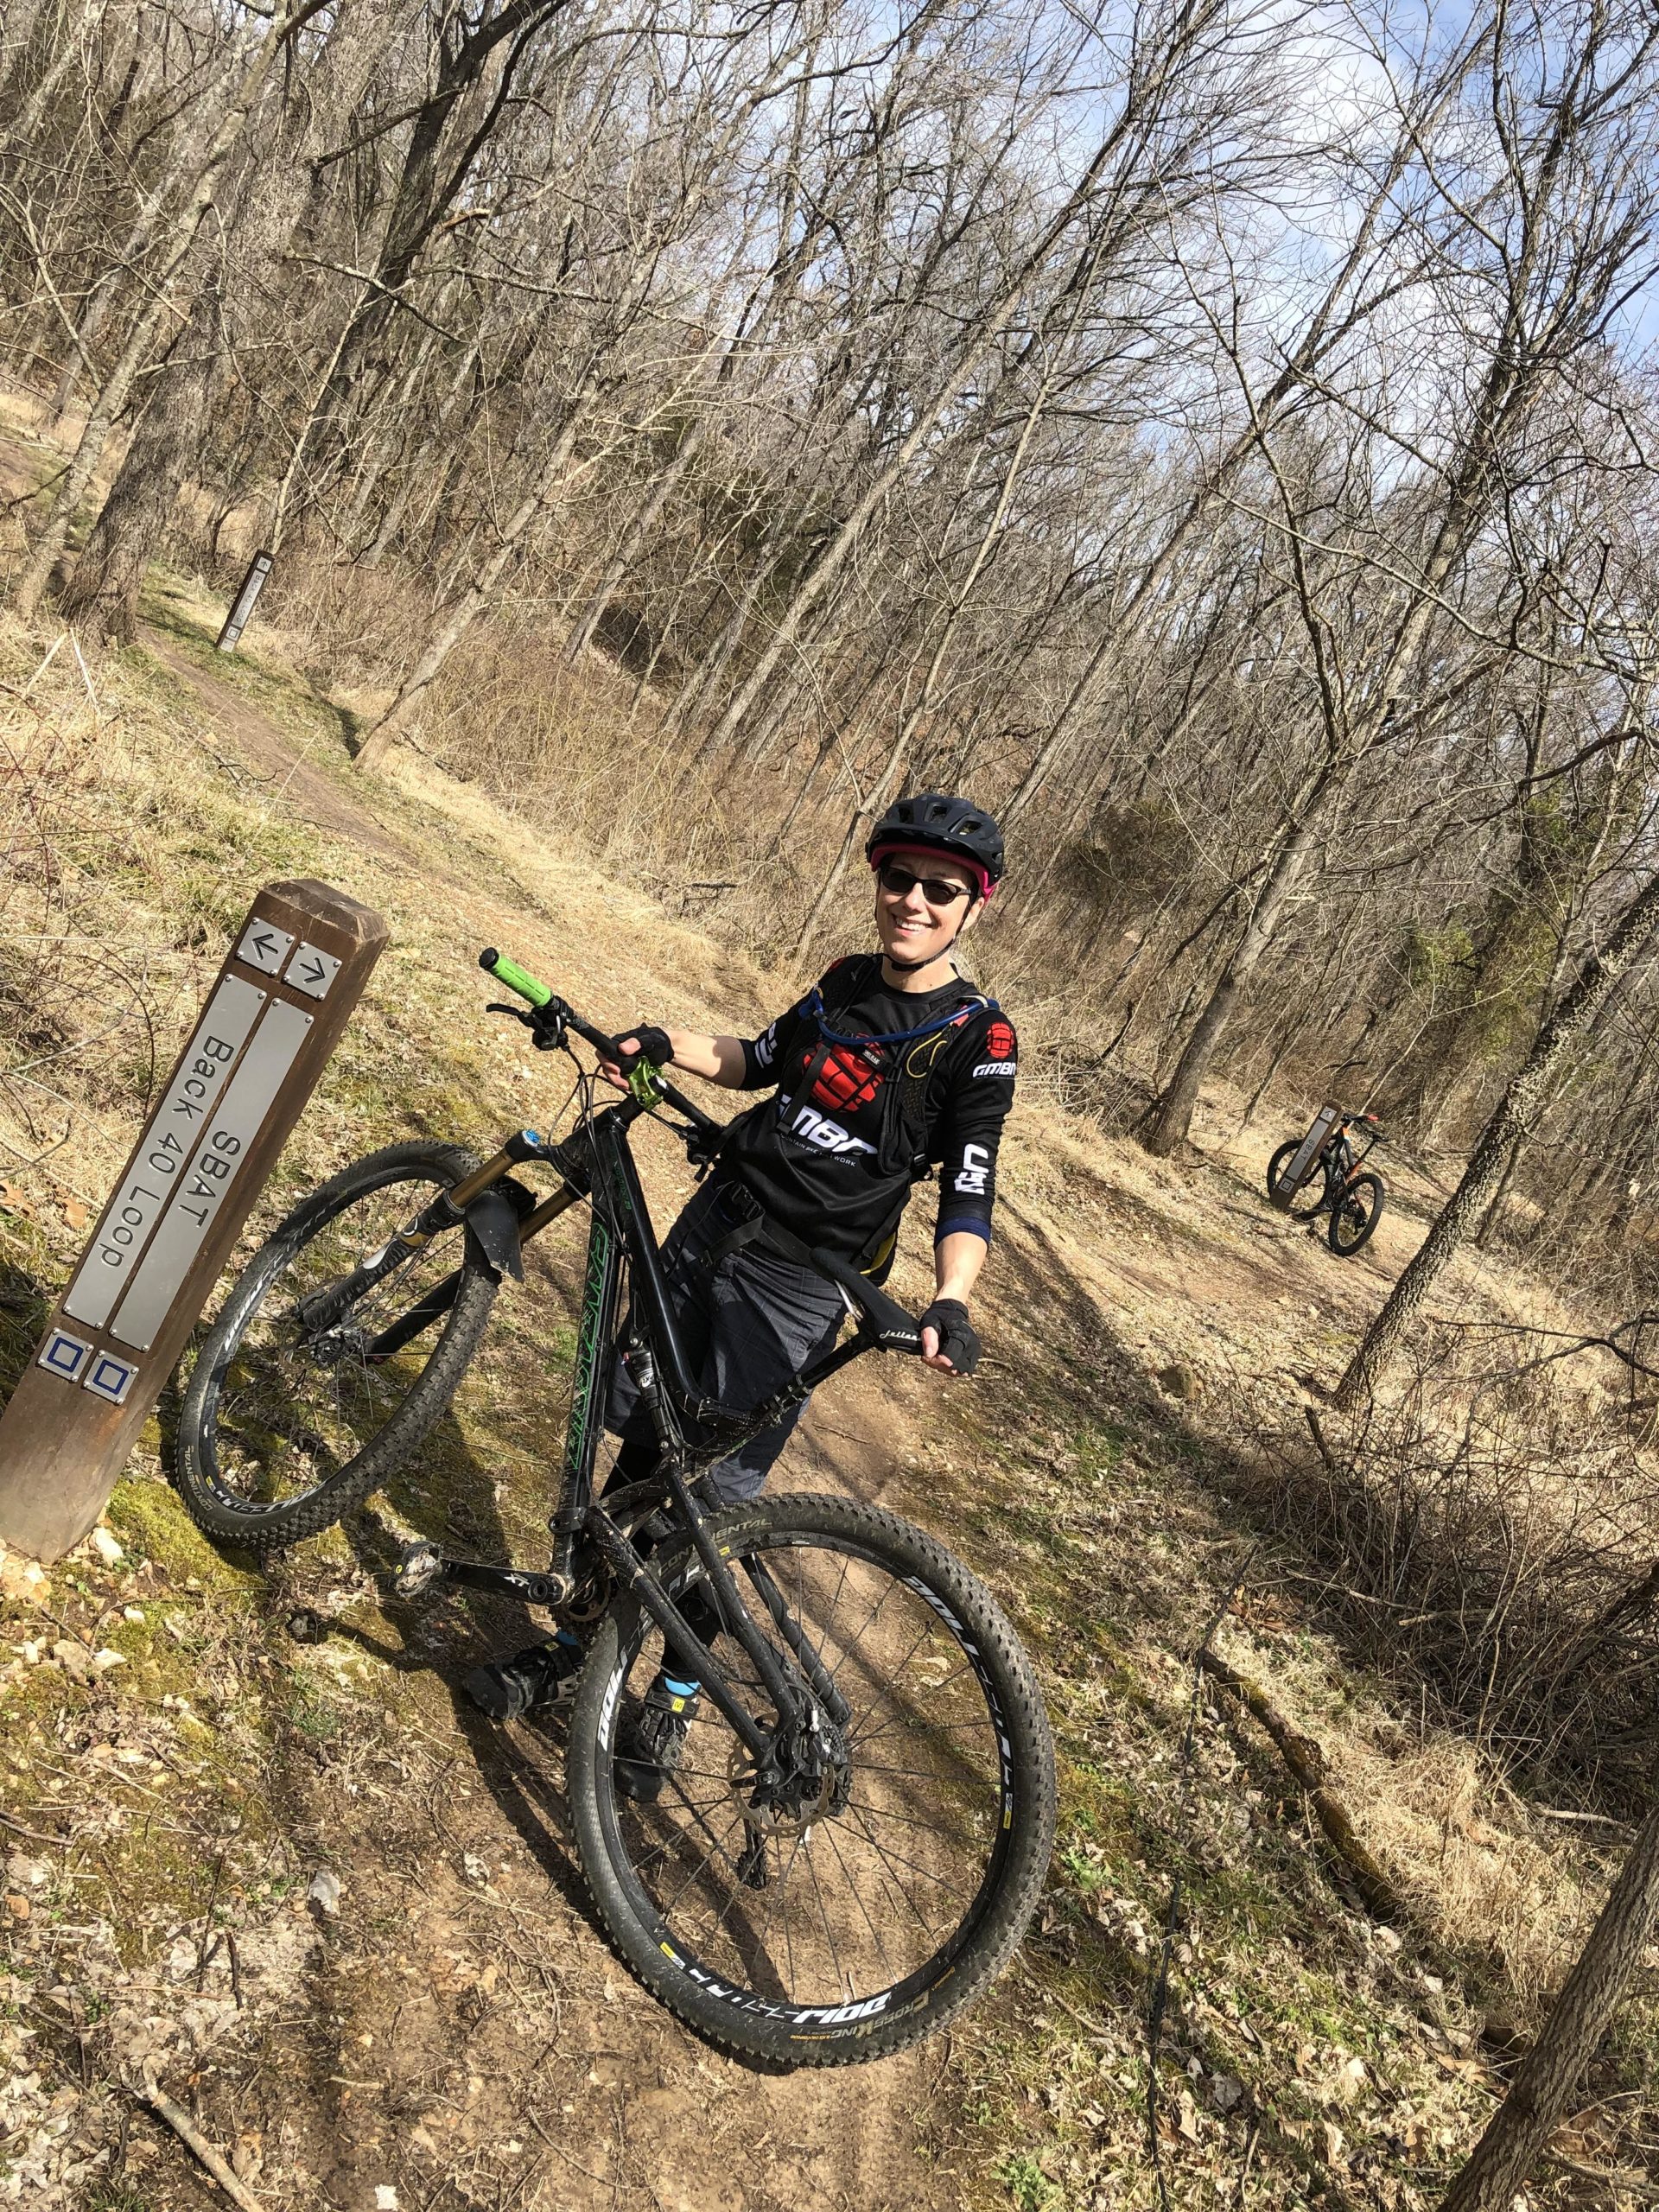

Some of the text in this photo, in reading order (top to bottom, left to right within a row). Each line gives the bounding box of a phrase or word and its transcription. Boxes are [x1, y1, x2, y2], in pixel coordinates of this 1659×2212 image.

[251, 575, 263, 591] Back
[236, 605, 248, 622] Loop
[972, 1062, 1016, 1077] GMBN
[99, 1035, 234, 1268] Back 40 Loop
[1300, 1139, 1315, 1160] SBAT
[178, 1130, 241, 1228] SBAT
[184, 1445, 213, 1511] CONTINENTAL
[658, 1518, 772, 1576] CONENTAL
[504, 1573, 530, 1587] XT
